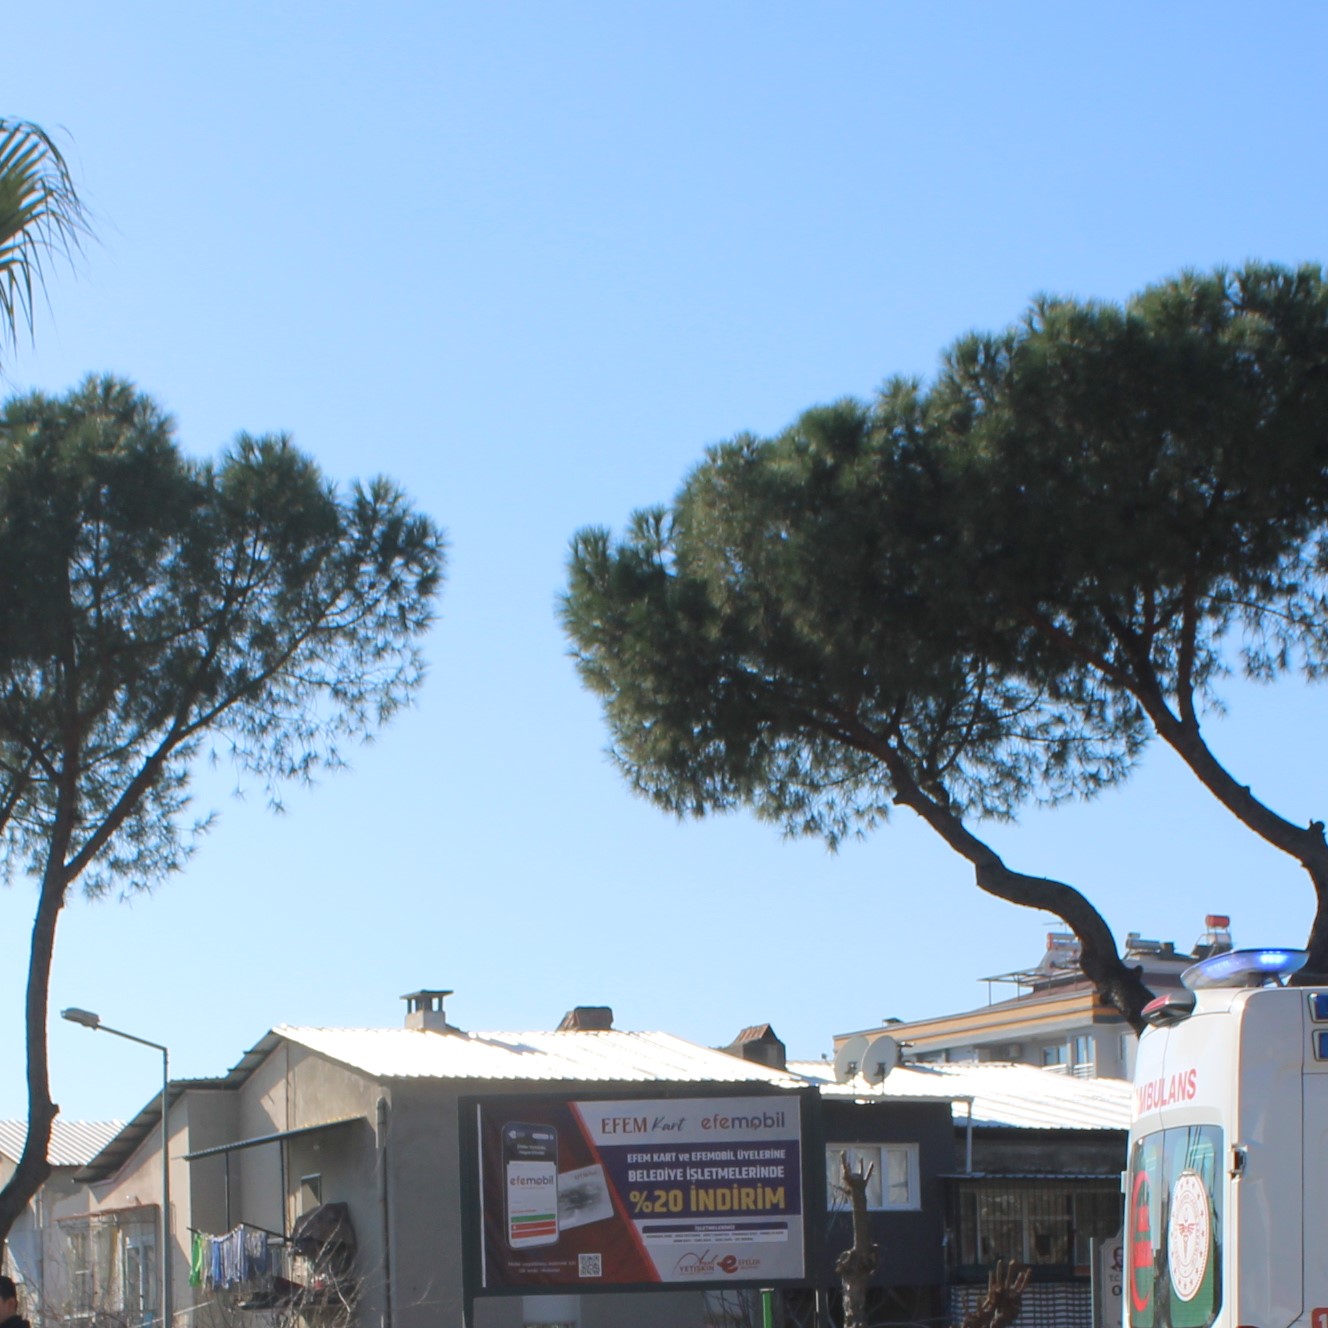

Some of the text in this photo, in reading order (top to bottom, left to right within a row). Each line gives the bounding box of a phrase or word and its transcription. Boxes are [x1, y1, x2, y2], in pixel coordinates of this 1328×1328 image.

[1136, 1068, 1197, 1115] MBULANS
[601, 1116, 686, 1134] EFEM Kart
[701, 1111, 785, 1130] efemobil
[627, 1148, 786, 1163] EFEM KART ve EFEMOBİL ÜYELERİNE
[510, 1175, 554, 1187] efemobil
[628, 1164, 785, 1183] BELEDİYE İŞLETMELERİNDE
[629, 1183, 785, 1213] %20 İNDİRİM
